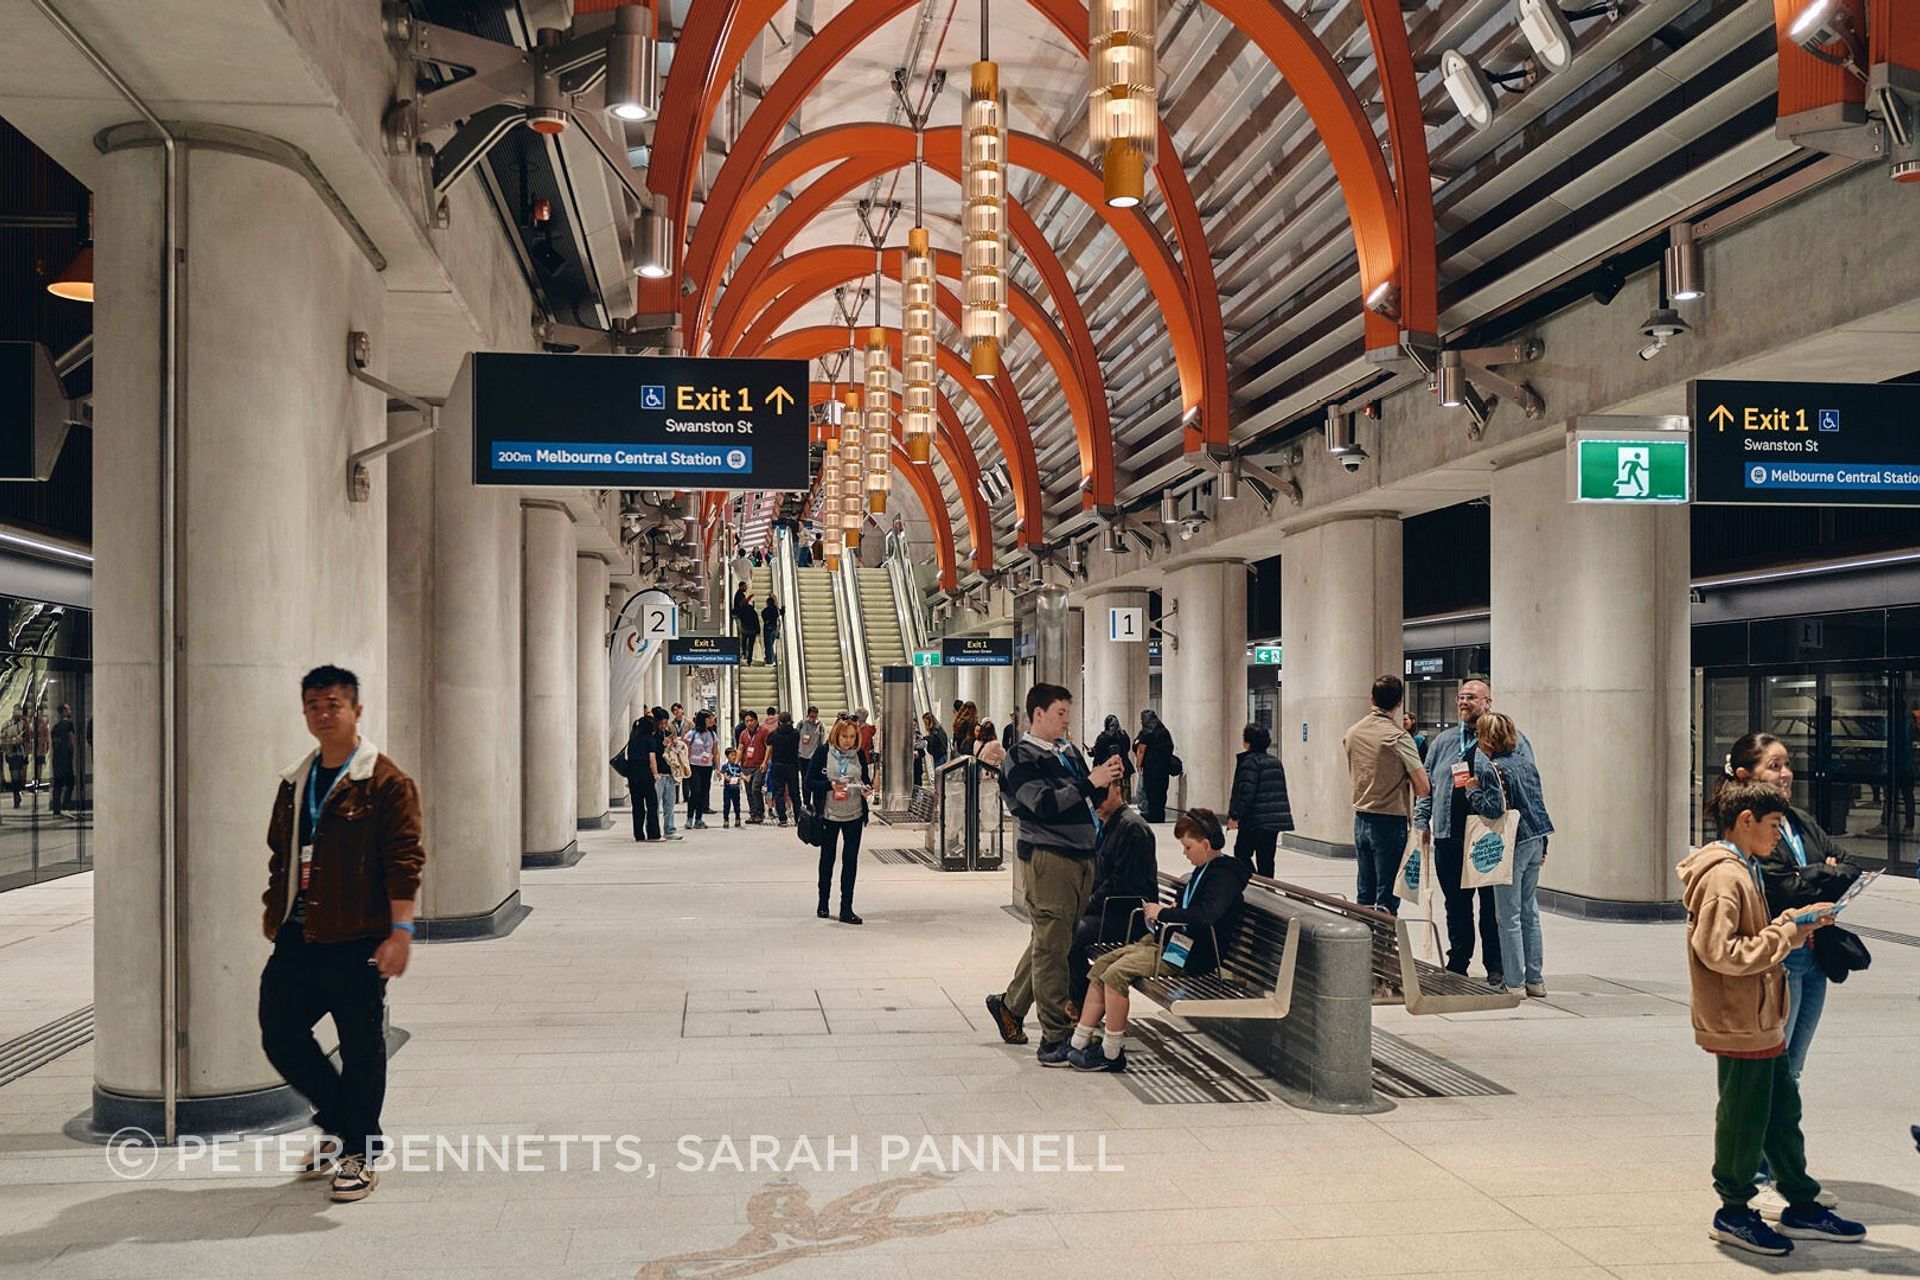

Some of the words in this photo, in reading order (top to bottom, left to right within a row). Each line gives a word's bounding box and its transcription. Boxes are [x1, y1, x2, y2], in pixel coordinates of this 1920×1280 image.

[677, 386, 731, 411] Exit
[737, 387, 753, 412] 1
[665, 418, 734, 433] Swanston
[737, 420, 753, 434] St
[1744, 407, 1790, 431] Exit
[1795, 409, 1809, 431] 1
[1744, 438, 1803, 452] Swanston
[1805, 439, 1819, 452] St
[498, 451, 532, 463] 200m
[536, 449, 612, 464] Melbourne
[615, 451, 668, 465] Central
[670, 452, 722, 466] Station
[1771, 469, 1834, 483] Melbourne
[1836, 470, 1881, 484] Central
[1883, 471, 1920, 484] Statio
[650, 610, 665, 632] 2
[1123, 614, 1134, 635] 1
[694, 639, 709, 647] Exit
